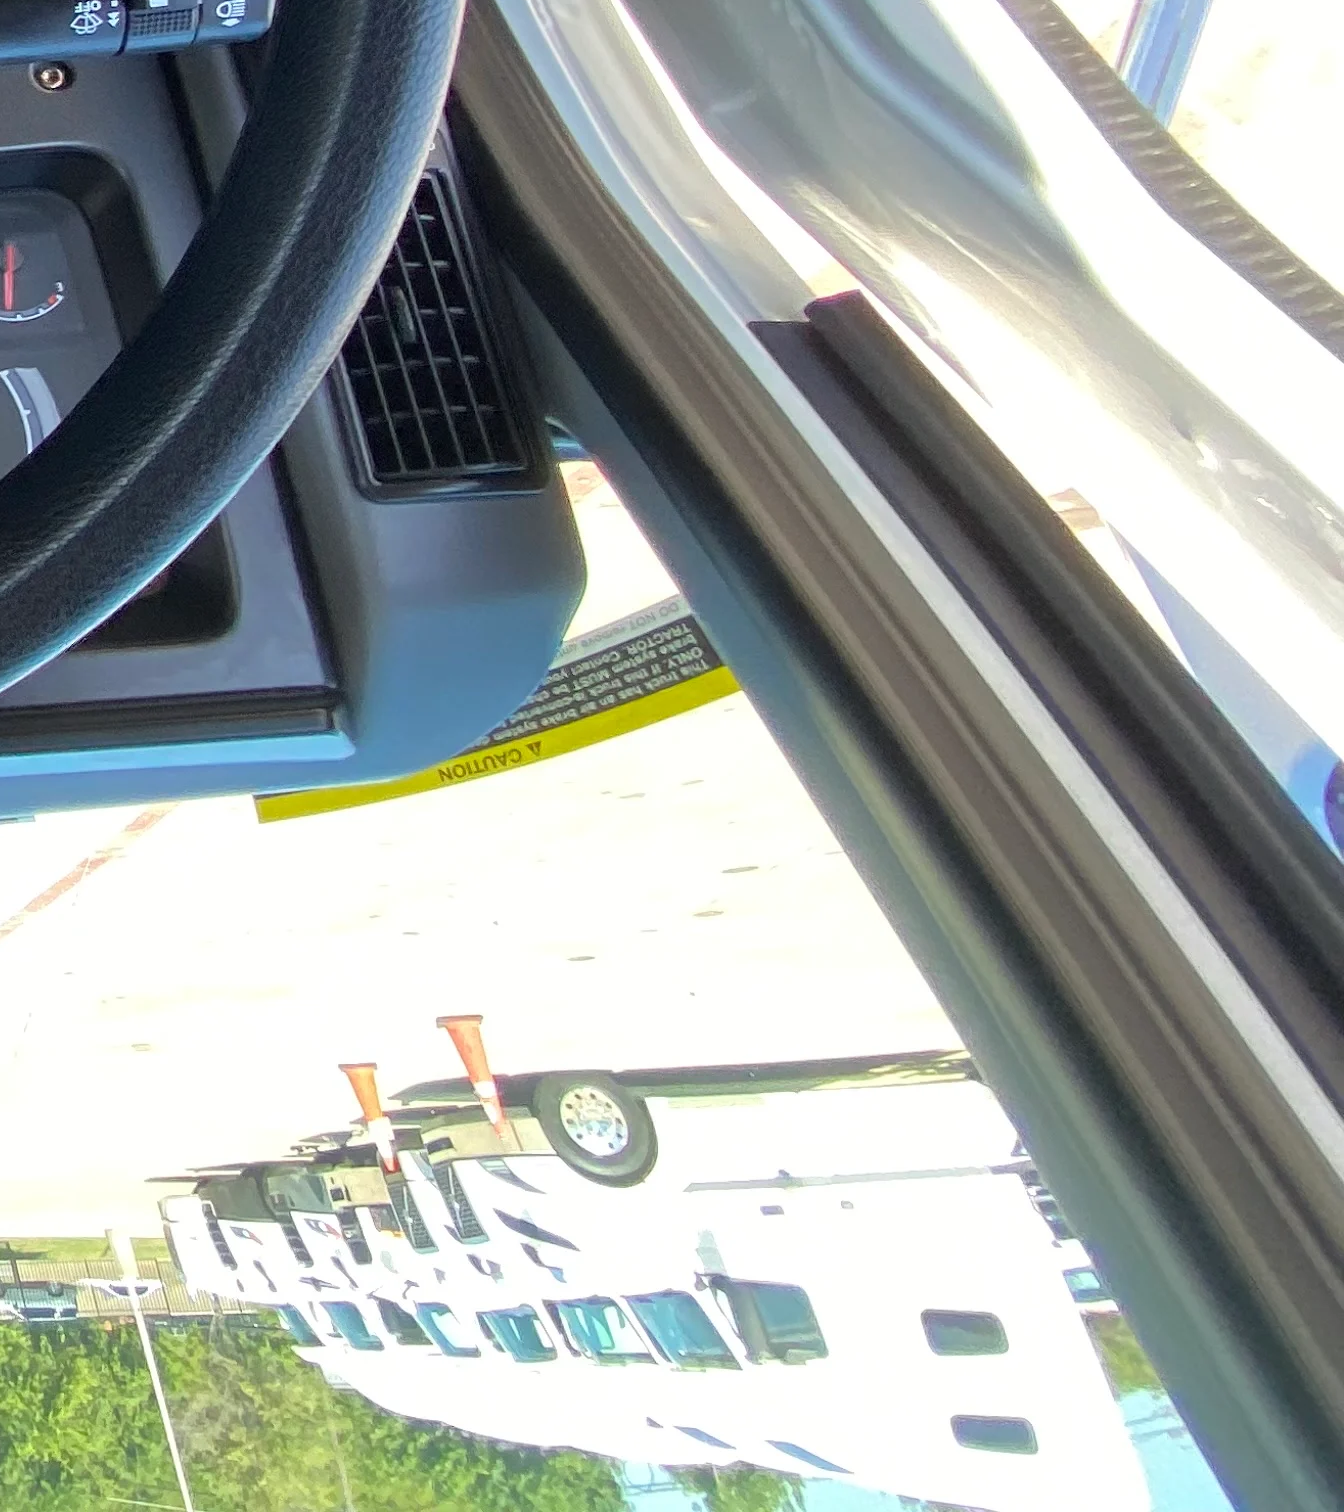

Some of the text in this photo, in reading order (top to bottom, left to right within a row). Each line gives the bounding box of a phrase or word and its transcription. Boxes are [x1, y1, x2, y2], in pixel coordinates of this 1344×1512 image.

[74, 0, 102, 13] OFF
[627, 610, 655, 630] NOT
[658, 602, 679, 618] DO
[659, 634, 697, 655] brake
[571, 651, 620, 678] Contact
[612, 650, 655, 672] system
[572, 668, 610, 690] MUST
[623, 669, 648, 684] this
[644, 671, 678, 691] truck
[552, 684, 568, 697] be
[588, 678, 621, 697] truck
[618, 684, 641, 700] has
[599, 693, 615, 707] an
[541, 707, 576, 728] brake
[494, 720, 537, 741] system
[438, 748, 522, 782] CAUTION
